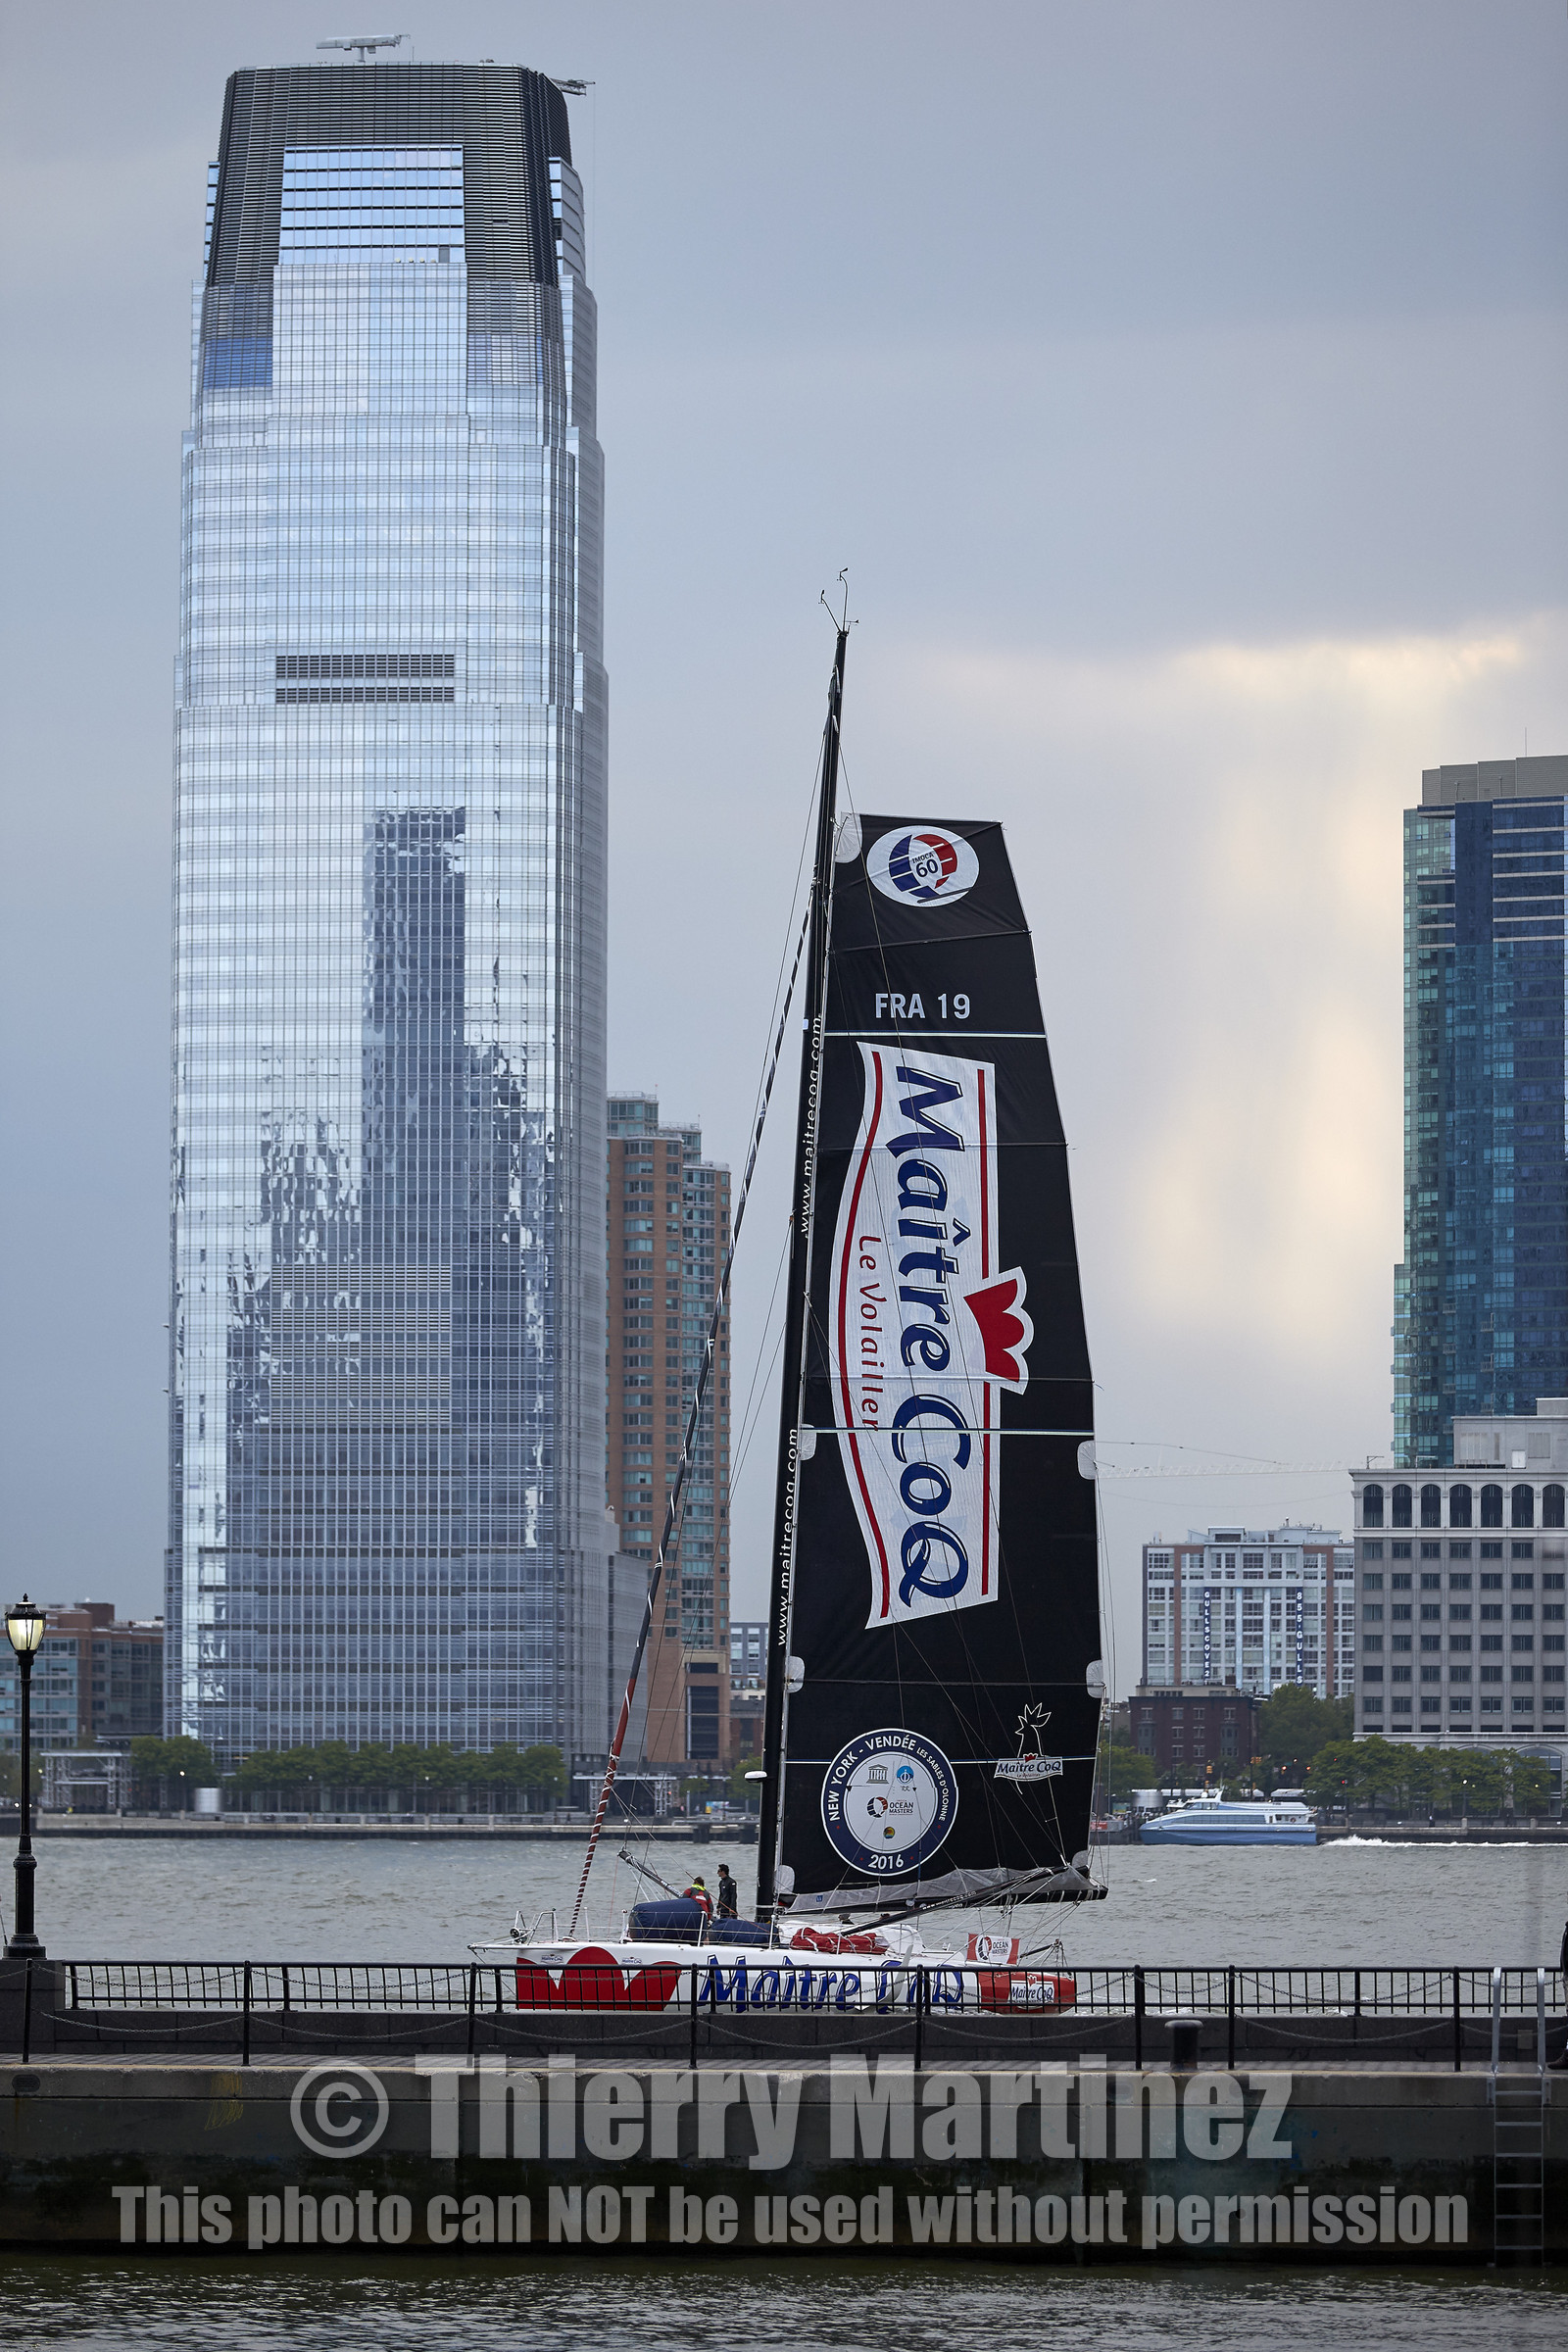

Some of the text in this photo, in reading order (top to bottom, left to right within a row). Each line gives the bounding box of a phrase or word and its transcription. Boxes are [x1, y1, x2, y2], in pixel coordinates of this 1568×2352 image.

[911, 852, 935, 864] IMOCA
[915, 858, 939, 878] 60
[875, 993, 970, 1019] FRA 19
[858, 1235, 888, 1432] Le Volailler
[885, 1065, 971, 1608] Maître CoQ
[778, 1428, 798, 1646] www.maitrecoq.com
[864, 1734, 917, 1751] VENDÉE
[831, 1750, 858, 1786] YORK
[997, 1760, 1062, 1774] Maître CoQ
[916, 1746, 950, 1822] LES SABLES D'OLONNE
[828, 1789, 841, 1822] NEW
[867, 1853, 905, 1870] 2016
[993, 1940, 1009, 1949] OCEAN
